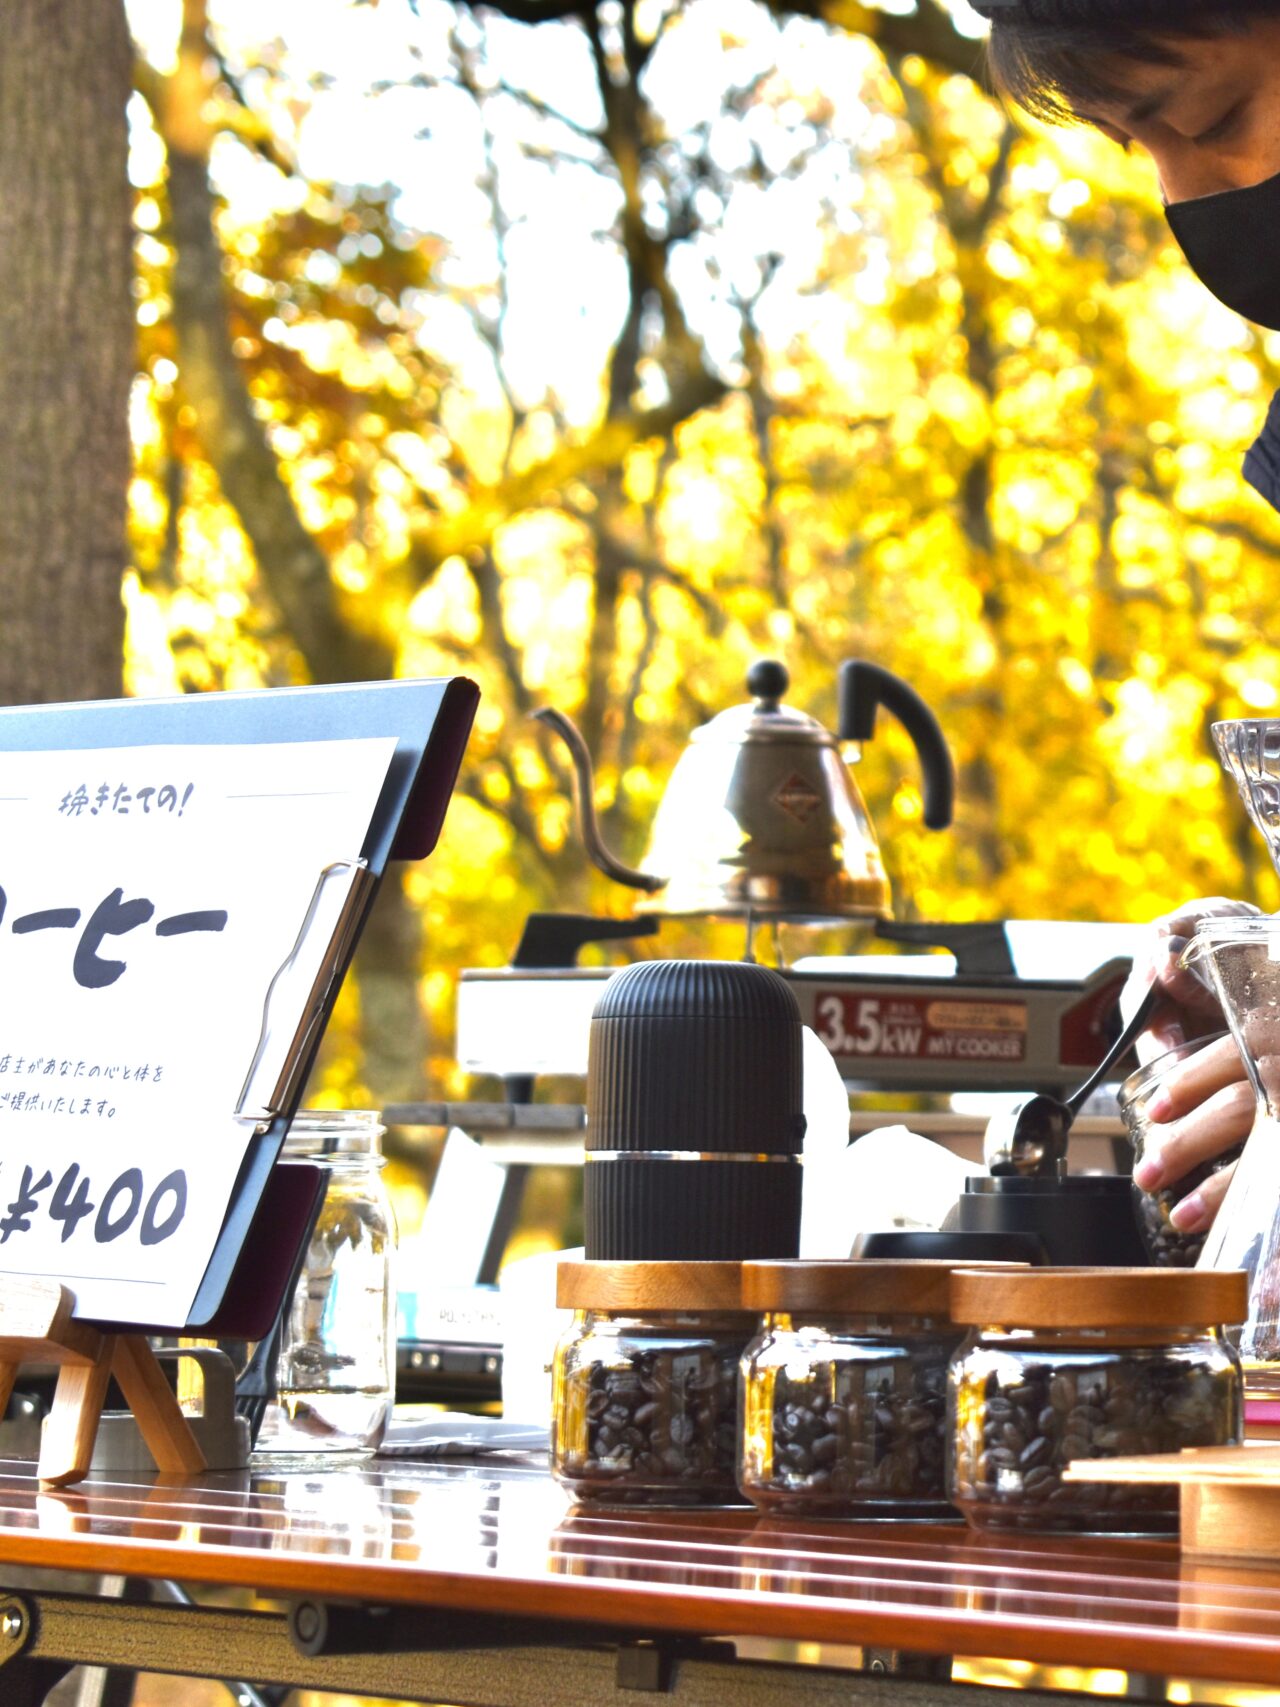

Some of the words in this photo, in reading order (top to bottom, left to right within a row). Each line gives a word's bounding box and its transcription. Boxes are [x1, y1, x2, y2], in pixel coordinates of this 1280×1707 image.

[0, 885, 228, 989] ーヒー
[0, 1162, 188, 1245] ¥400
